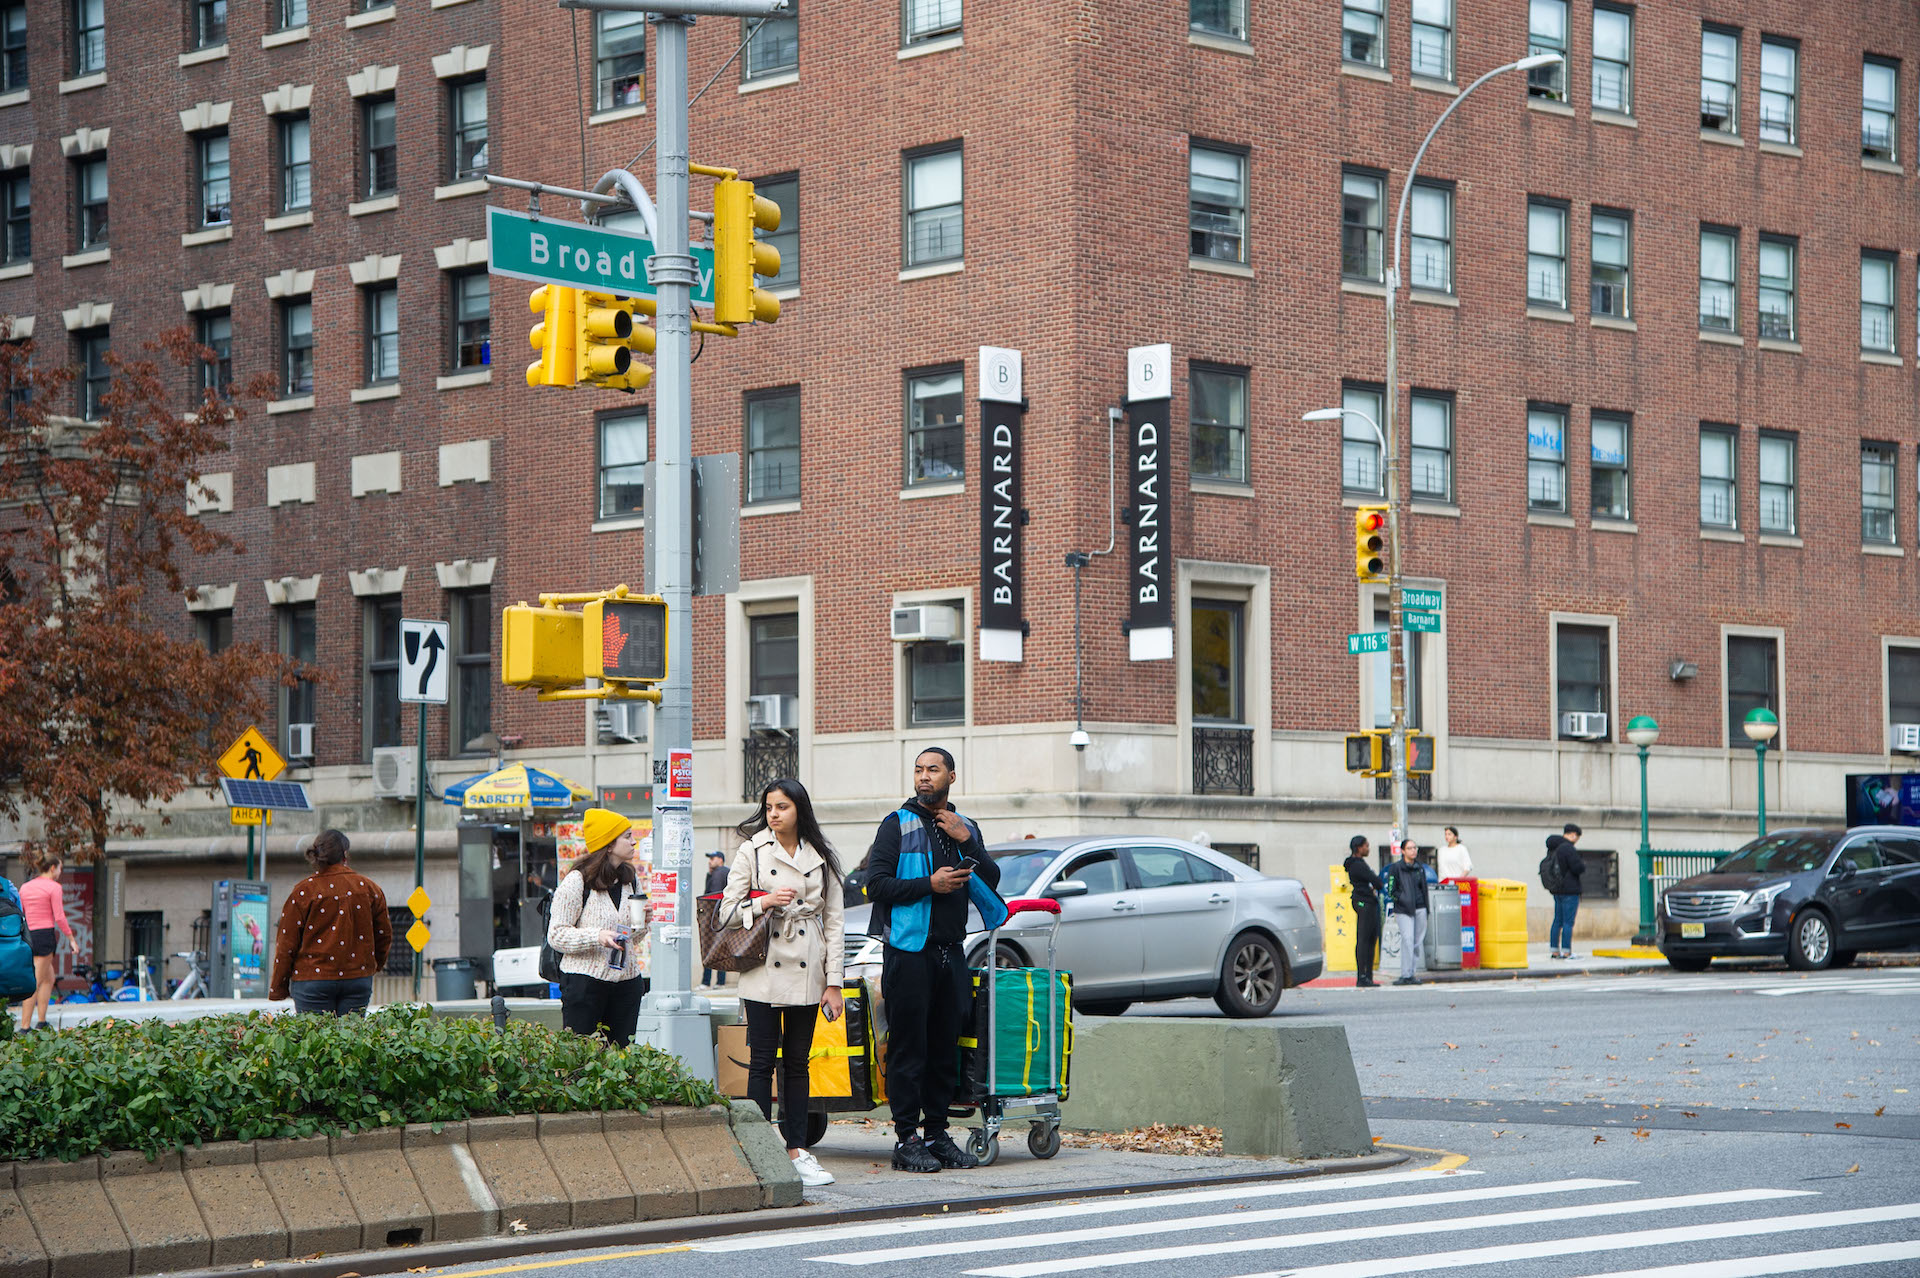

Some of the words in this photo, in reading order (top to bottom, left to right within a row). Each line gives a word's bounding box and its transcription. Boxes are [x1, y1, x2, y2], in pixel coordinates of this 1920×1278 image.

[530, 232, 713, 297] Broady
[998, 365, 1009, 383] B
[1143, 364, 1153, 382] B
[993, 424, 1012, 604] BARNARD
[1138, 422, 1158, 603] BARNARD
[1402, 591, 1440, 609] Broadway
[1408, 613, 1435, 625] Barnard
[1350, 636, 1360, 651] W
[1362, 634, 1378, 651] 116
[469, 794, 526, 805] SABRETT
[235, 808, 267, 819] AHEA
